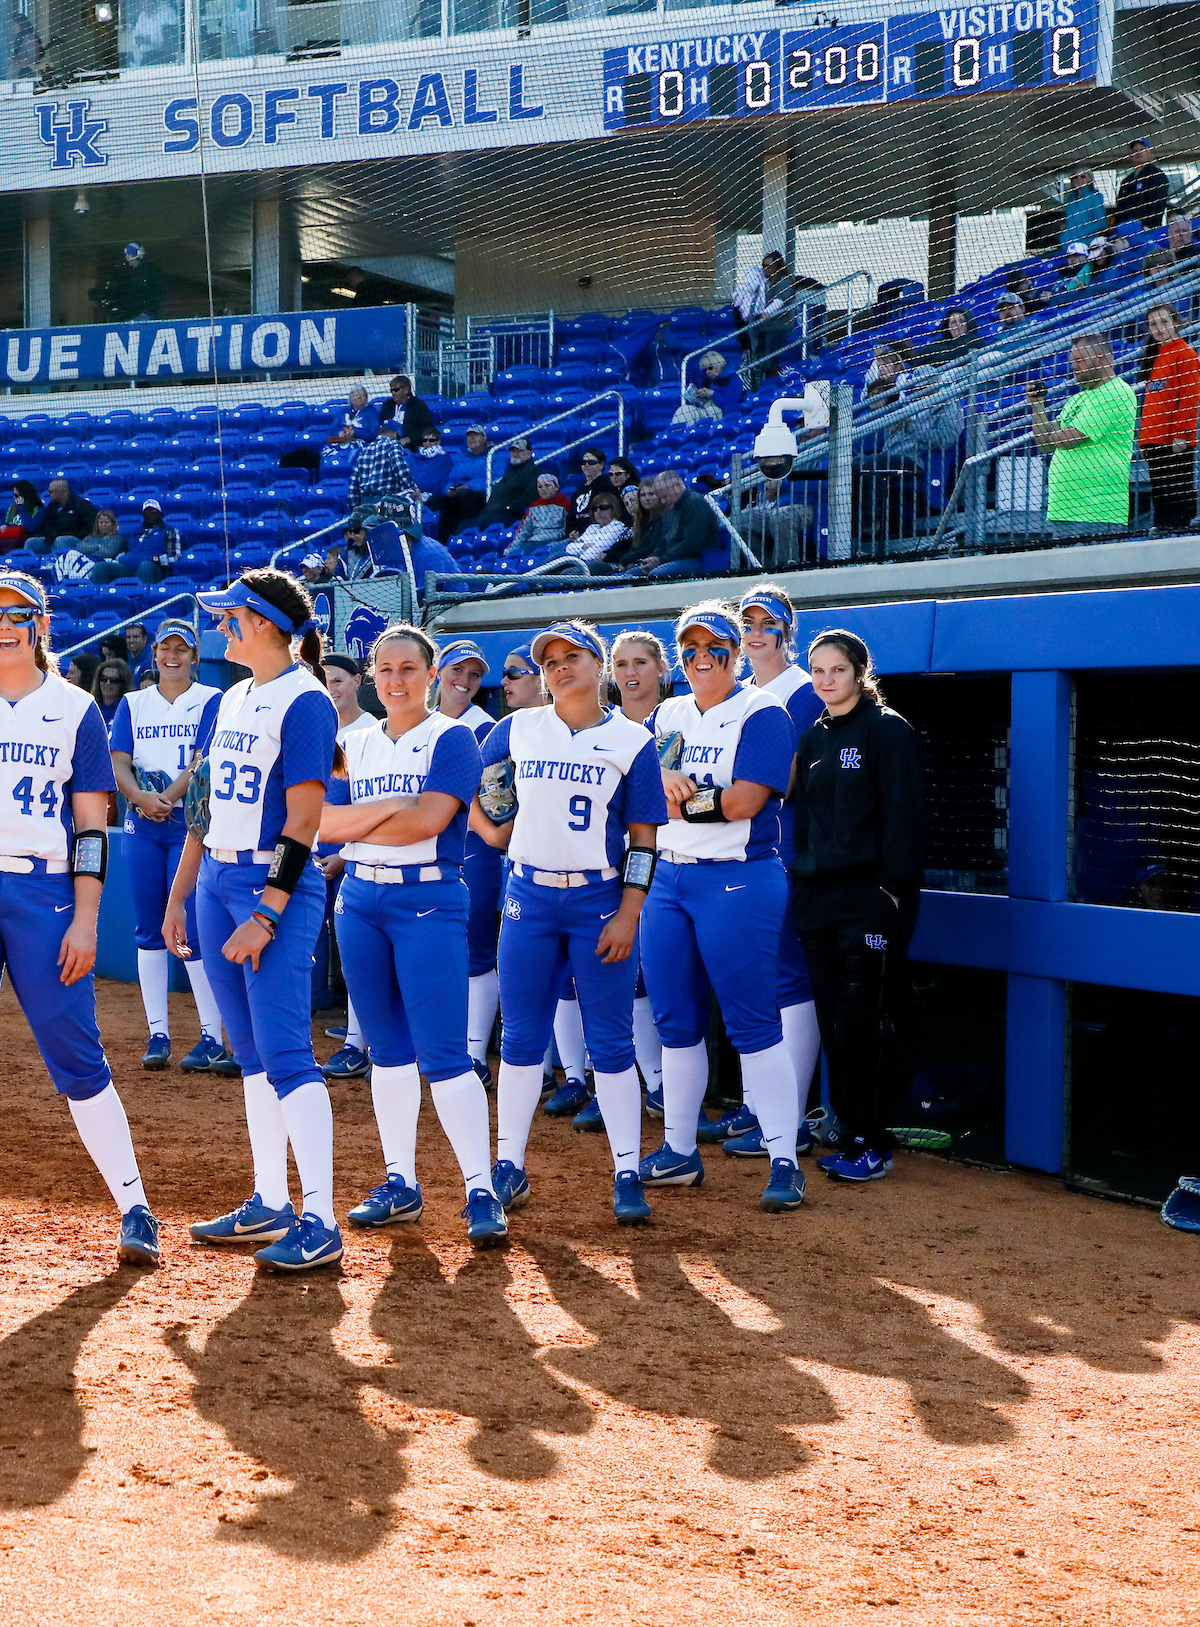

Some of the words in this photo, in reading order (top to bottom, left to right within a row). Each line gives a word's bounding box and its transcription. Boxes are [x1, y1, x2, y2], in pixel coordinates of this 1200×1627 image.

[939, 0, 1075, 39] VISITORS
[627, 32, 766, 75] KENTUCKY
[790, 43, 879, 88] 2:00
[893, 56, 911, 84] R
[953, 38, 980, 86] 0
[988, 45, 1007, 74] H
[1053, 27, 1080, 76] 0
[162, 62, 545, 154] SOFTBALL
[606, 85, 624, 113] R
[659, 71, 684, 116] 0
[690, 76, 707, 105] H
[745, 61, 771, 108] 0
[34, 98, 109, 170] UK
[103, 317, 337, 377] NATION
[167, 626, 188, 634] KENTUCKY
[689, 615, 716, 623] KENTUCKY
[136, 724, 198, 739] KENTUCKY
[519, 760, 606, 786] KENTUCKY
[839, 747, 862, 769] UK
[12, 776, 58, 818] 44
[214, 760, 262, 804] 33
[353, 774, 428, 801] ENTUCKY
[567, 794, 593, 831] 9
[865, 934, 888, 951] UK
